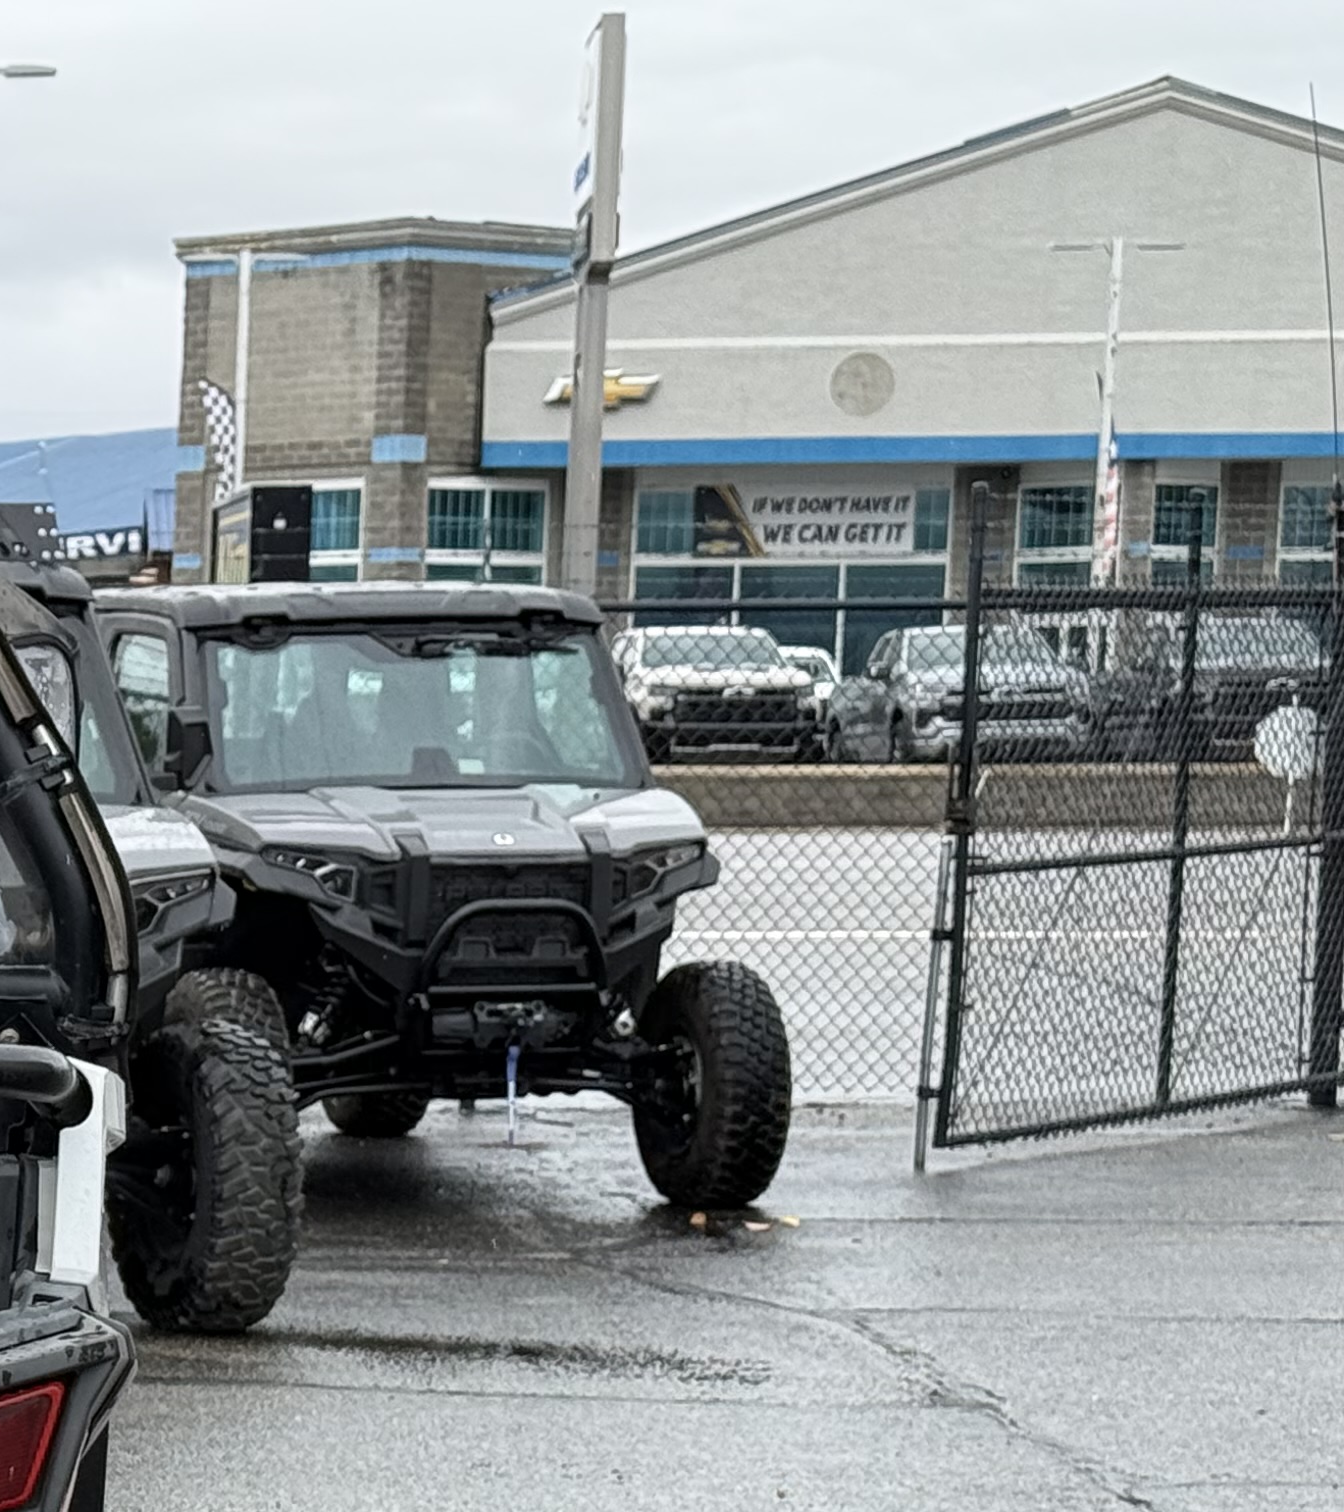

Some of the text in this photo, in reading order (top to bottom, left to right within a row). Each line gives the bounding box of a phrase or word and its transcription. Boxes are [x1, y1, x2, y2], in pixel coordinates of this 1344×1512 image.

[752, 495, 910, 514] IF WE DON'T HAVE IT
[763, 522, 907, 544] WE CAN GET IT
[58, 531, 142, 559] RVI
